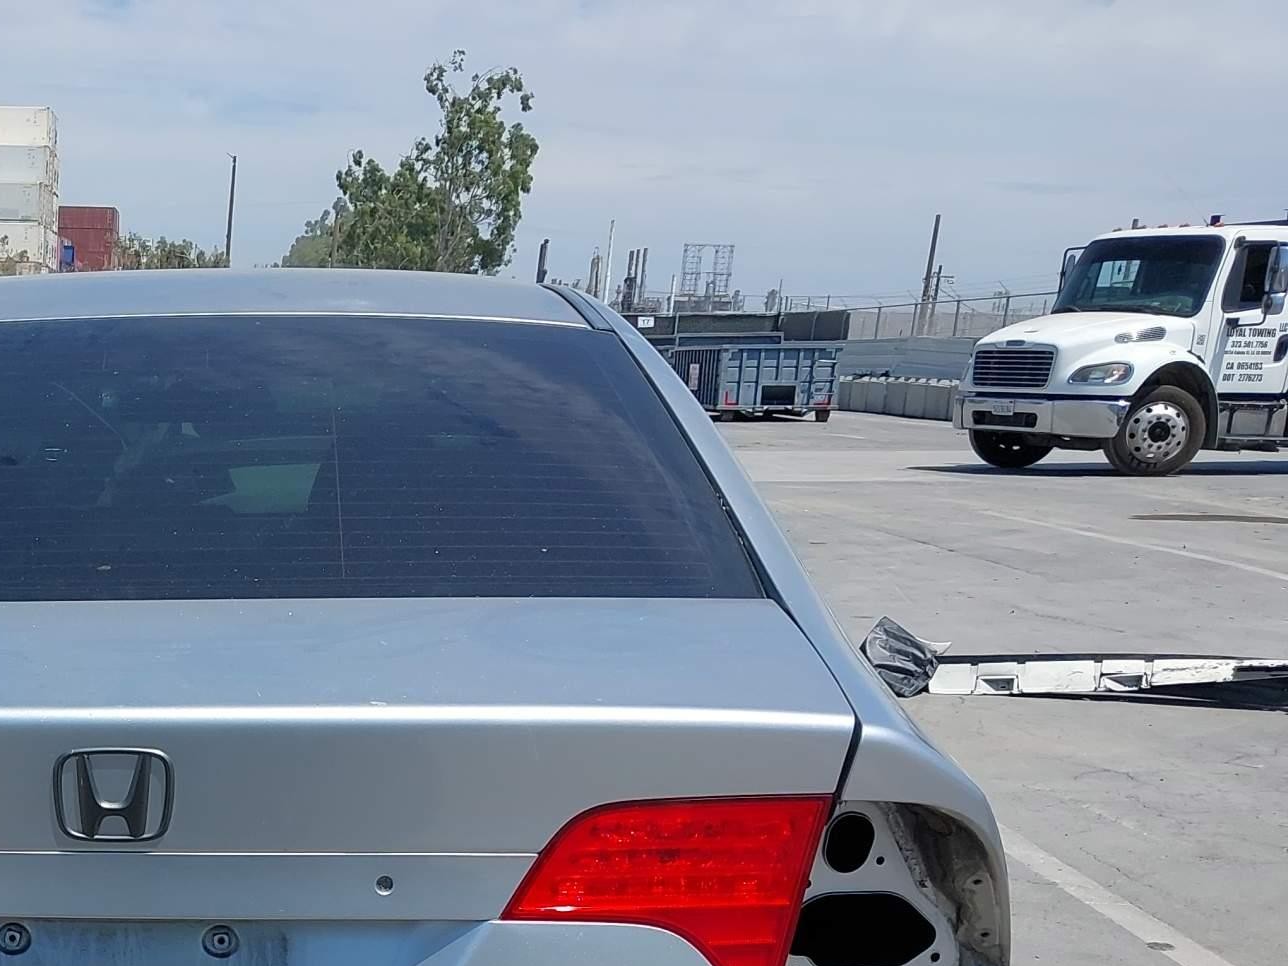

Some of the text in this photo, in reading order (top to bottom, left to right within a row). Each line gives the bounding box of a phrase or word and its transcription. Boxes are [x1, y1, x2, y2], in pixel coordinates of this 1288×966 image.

[1227, 328, 1246, 337] LOYAL
[1249, 328, 1277, 337] TOWING
[1225, 362, 1234, 370] CA
